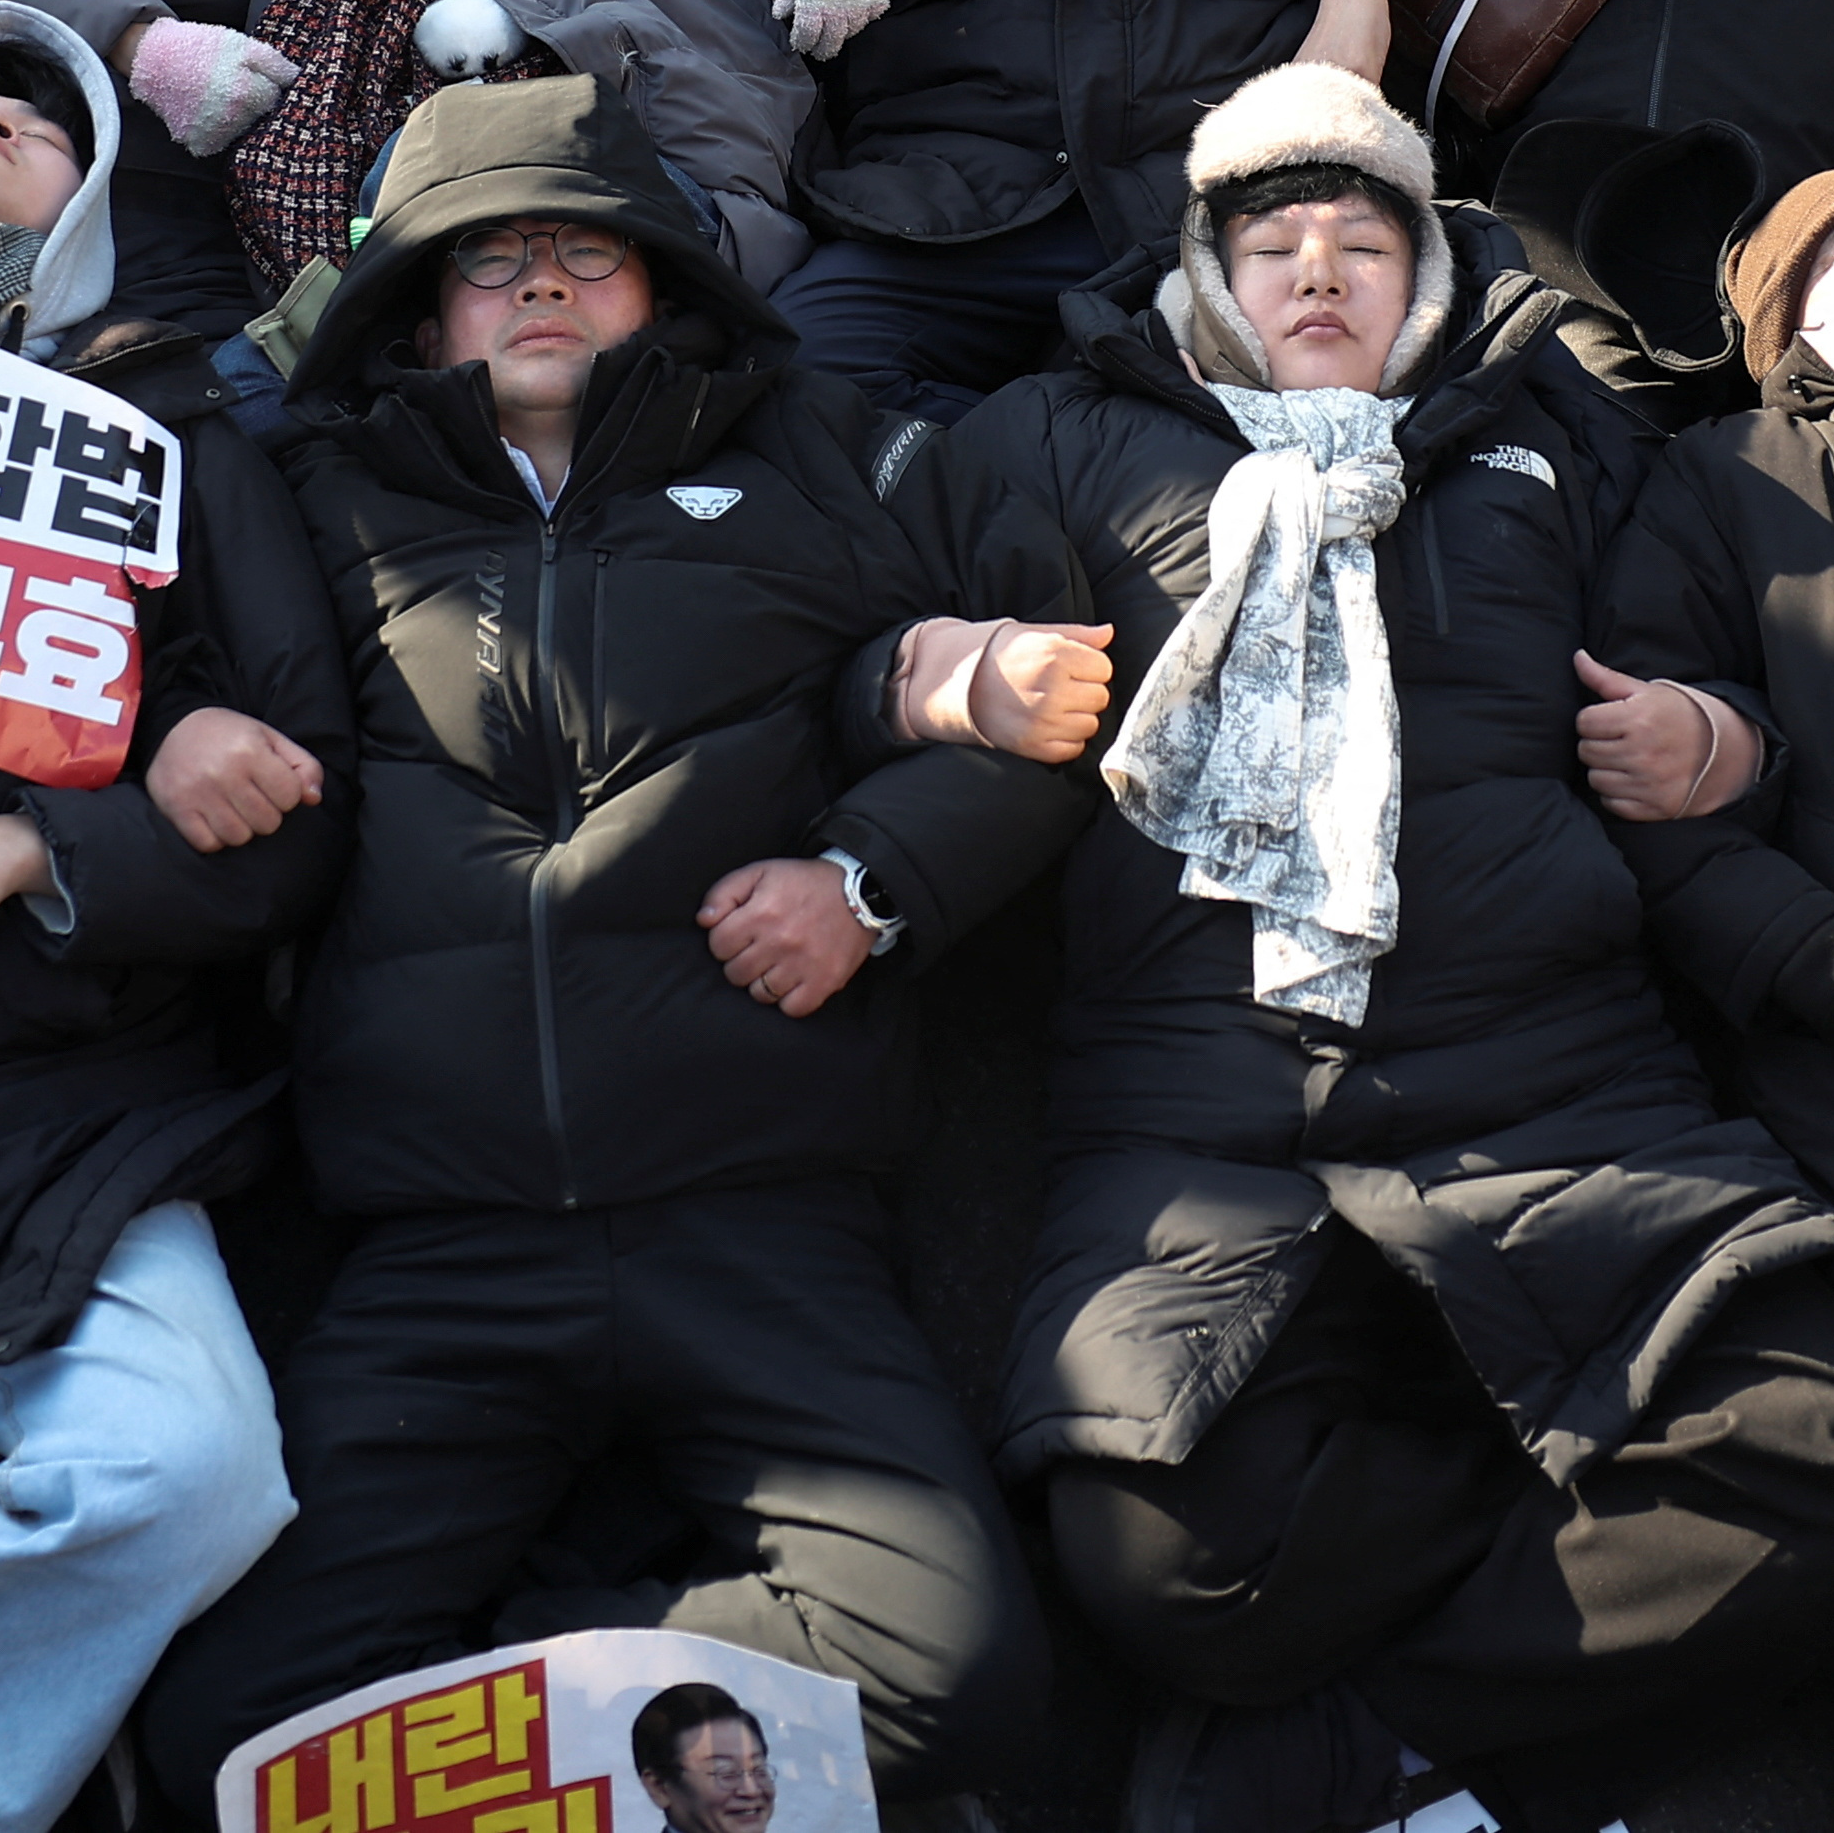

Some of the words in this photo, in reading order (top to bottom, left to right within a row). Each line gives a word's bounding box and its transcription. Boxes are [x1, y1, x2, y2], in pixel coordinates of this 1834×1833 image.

[1495, 445, 1527, 456] THE
[1470, 452, 1528, 465] NORTH
[1488, 461, 1531, 475] FACE
[475, 549, 513, 758] DYNAFIT
[270, 1671, 540, 1833] 내란
